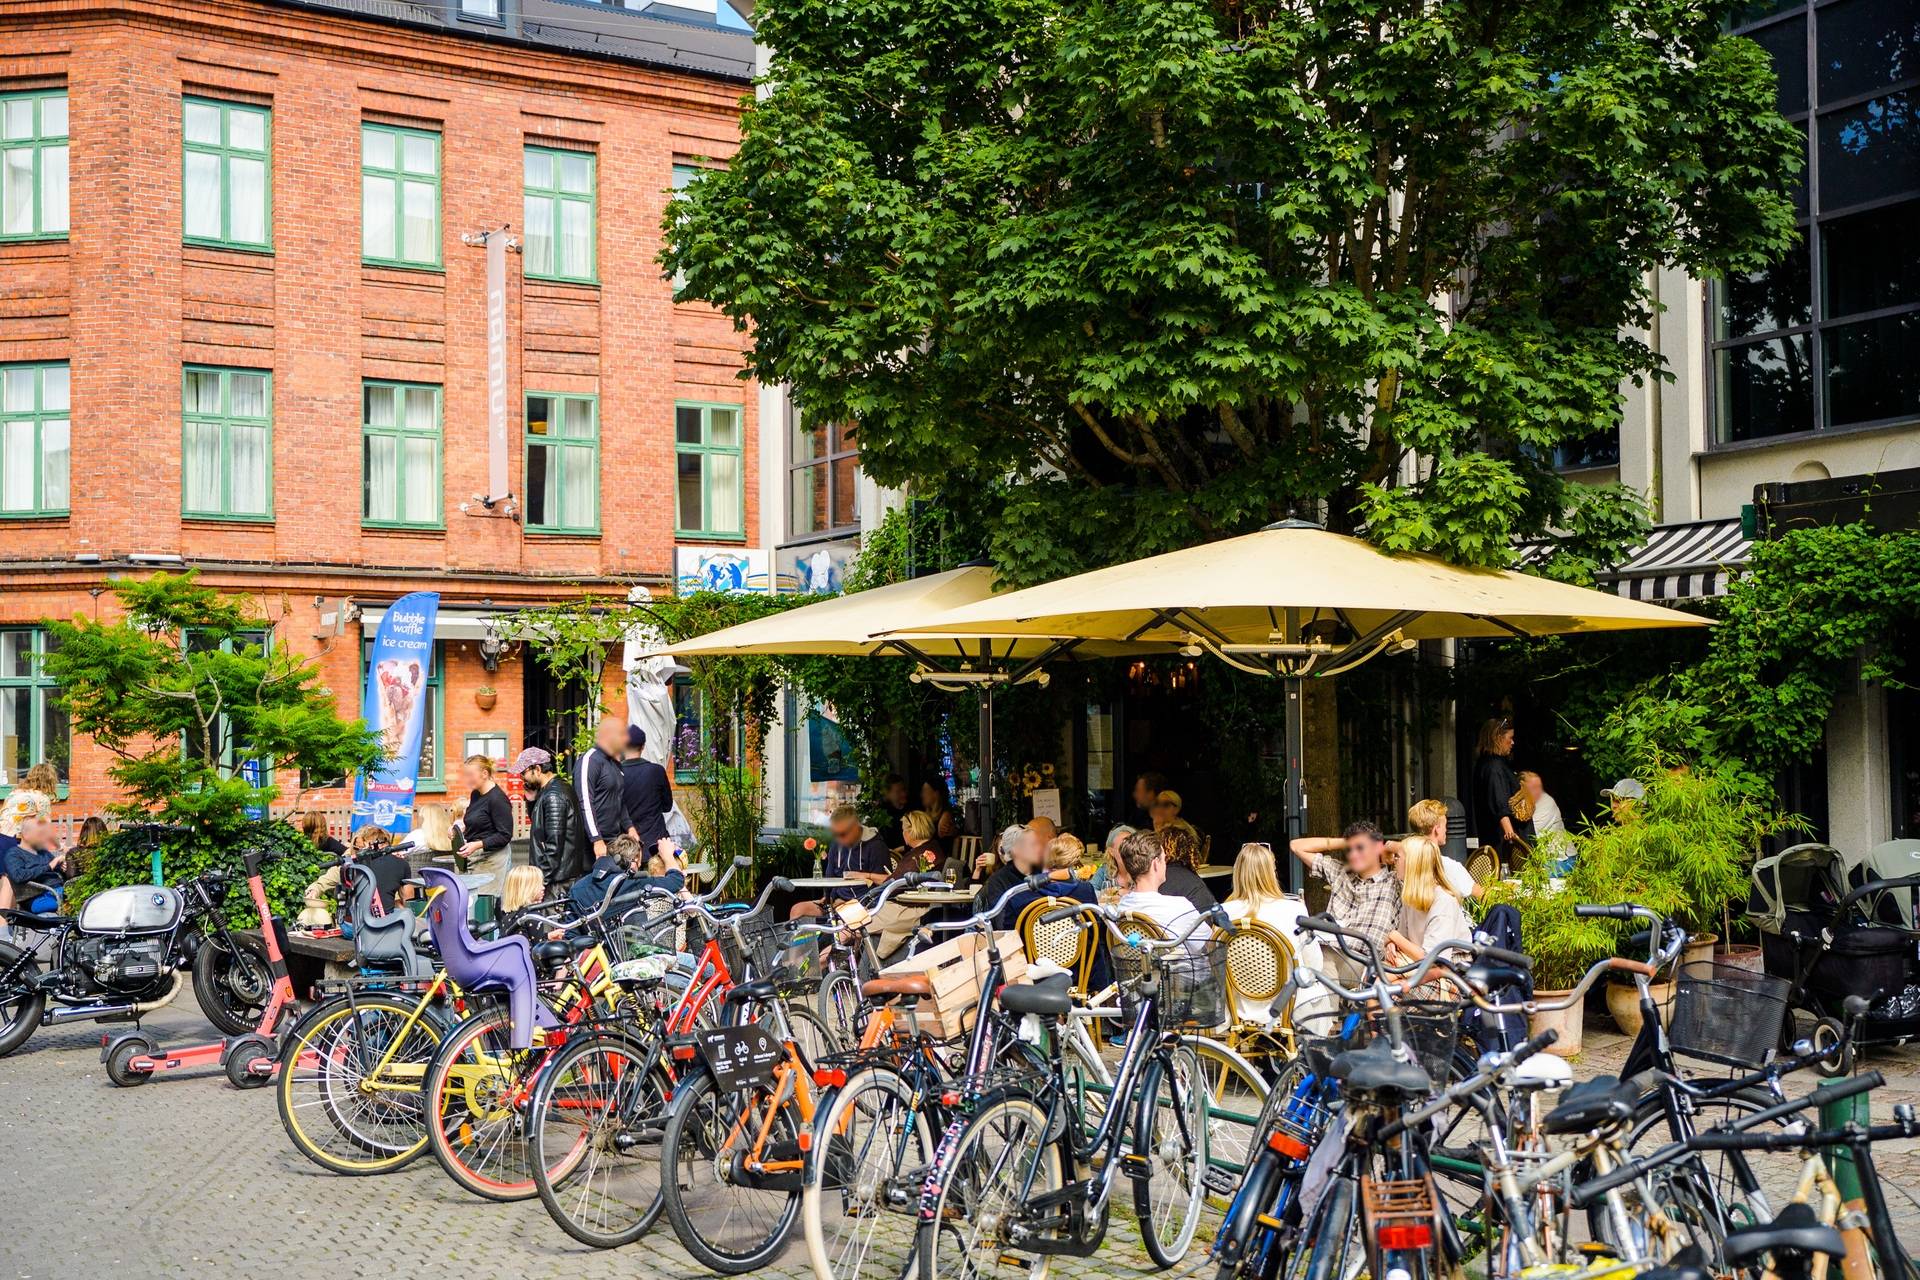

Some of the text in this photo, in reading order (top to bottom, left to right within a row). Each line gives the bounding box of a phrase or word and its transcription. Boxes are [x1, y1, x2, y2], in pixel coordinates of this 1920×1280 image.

[392, 611, 426, 624] Bubble
[393, 623, 424, 635] waffle
[382, 635, 427, 650] ice cream
